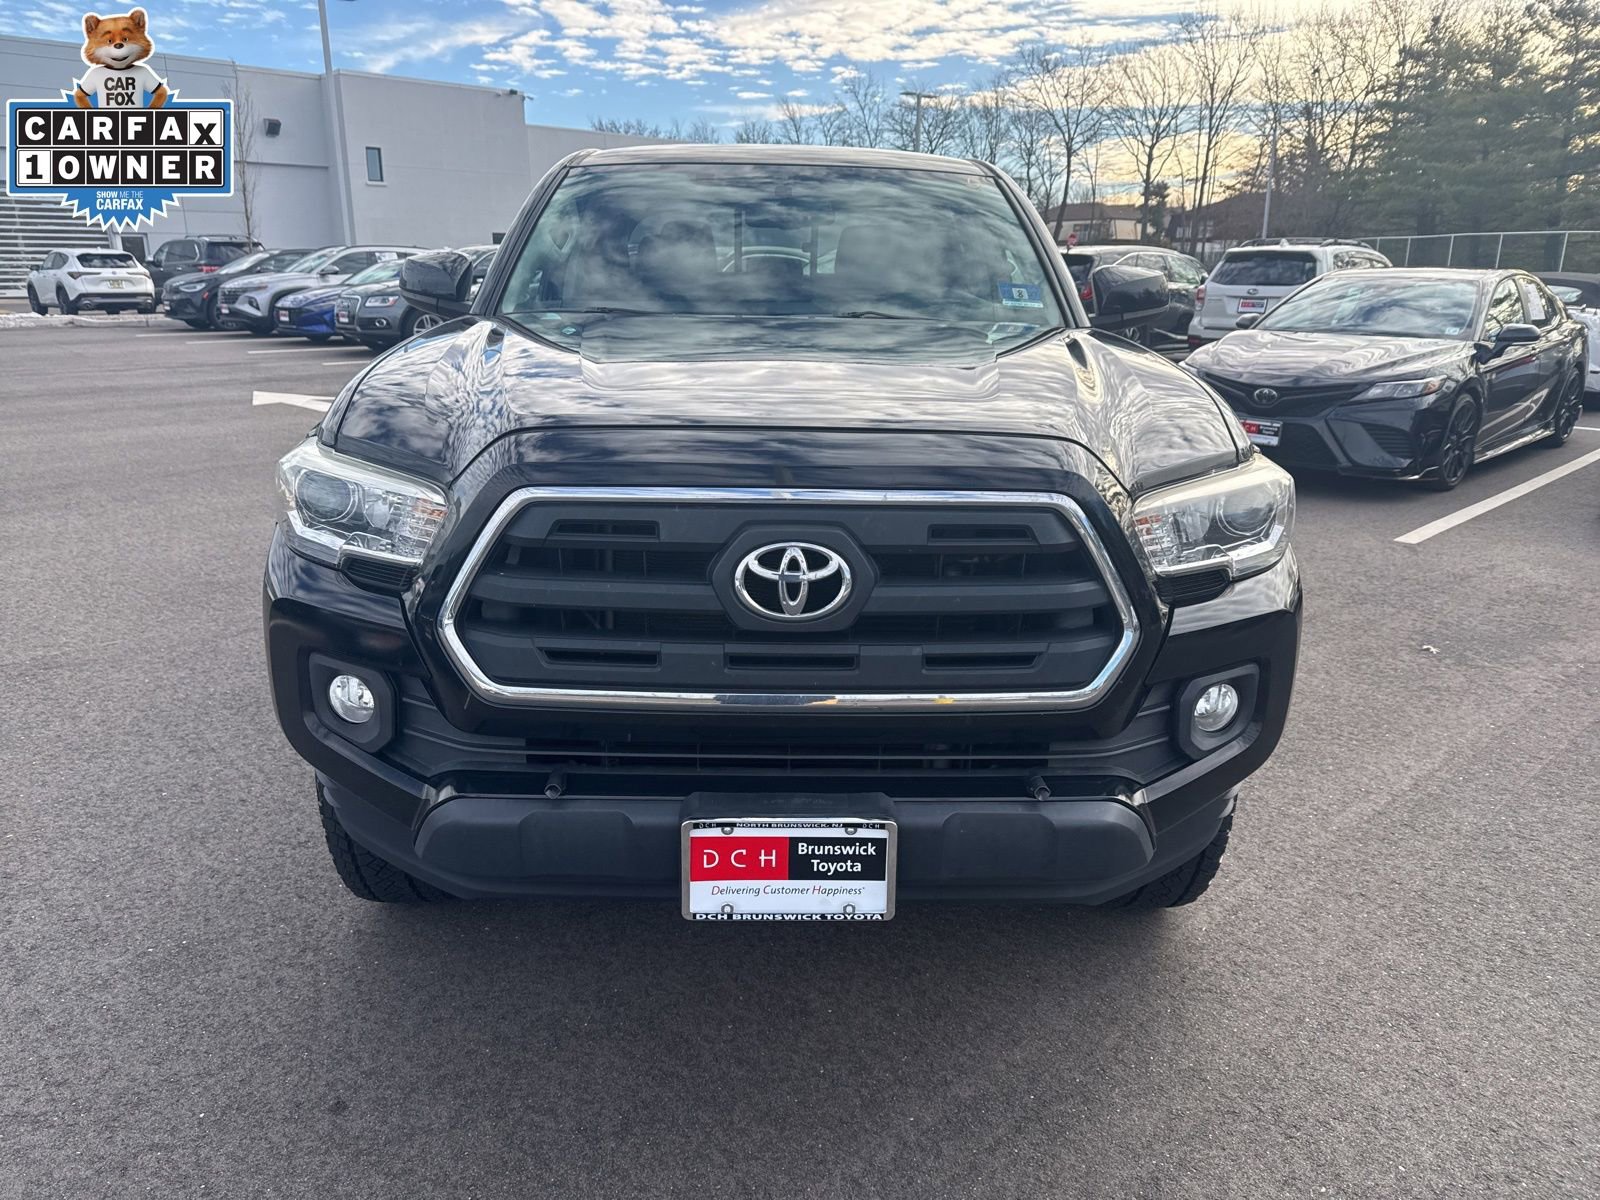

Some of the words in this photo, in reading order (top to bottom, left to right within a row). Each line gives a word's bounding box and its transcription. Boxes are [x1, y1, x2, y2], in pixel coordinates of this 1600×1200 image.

[798, 842, 877, 856] Brunswick
[703, 849, 776, 868] DCH
[810, 859, 862, 876] Toyota
[711, 885, 761, 897] Delivering
[763, 884, 810, 895] Customer
